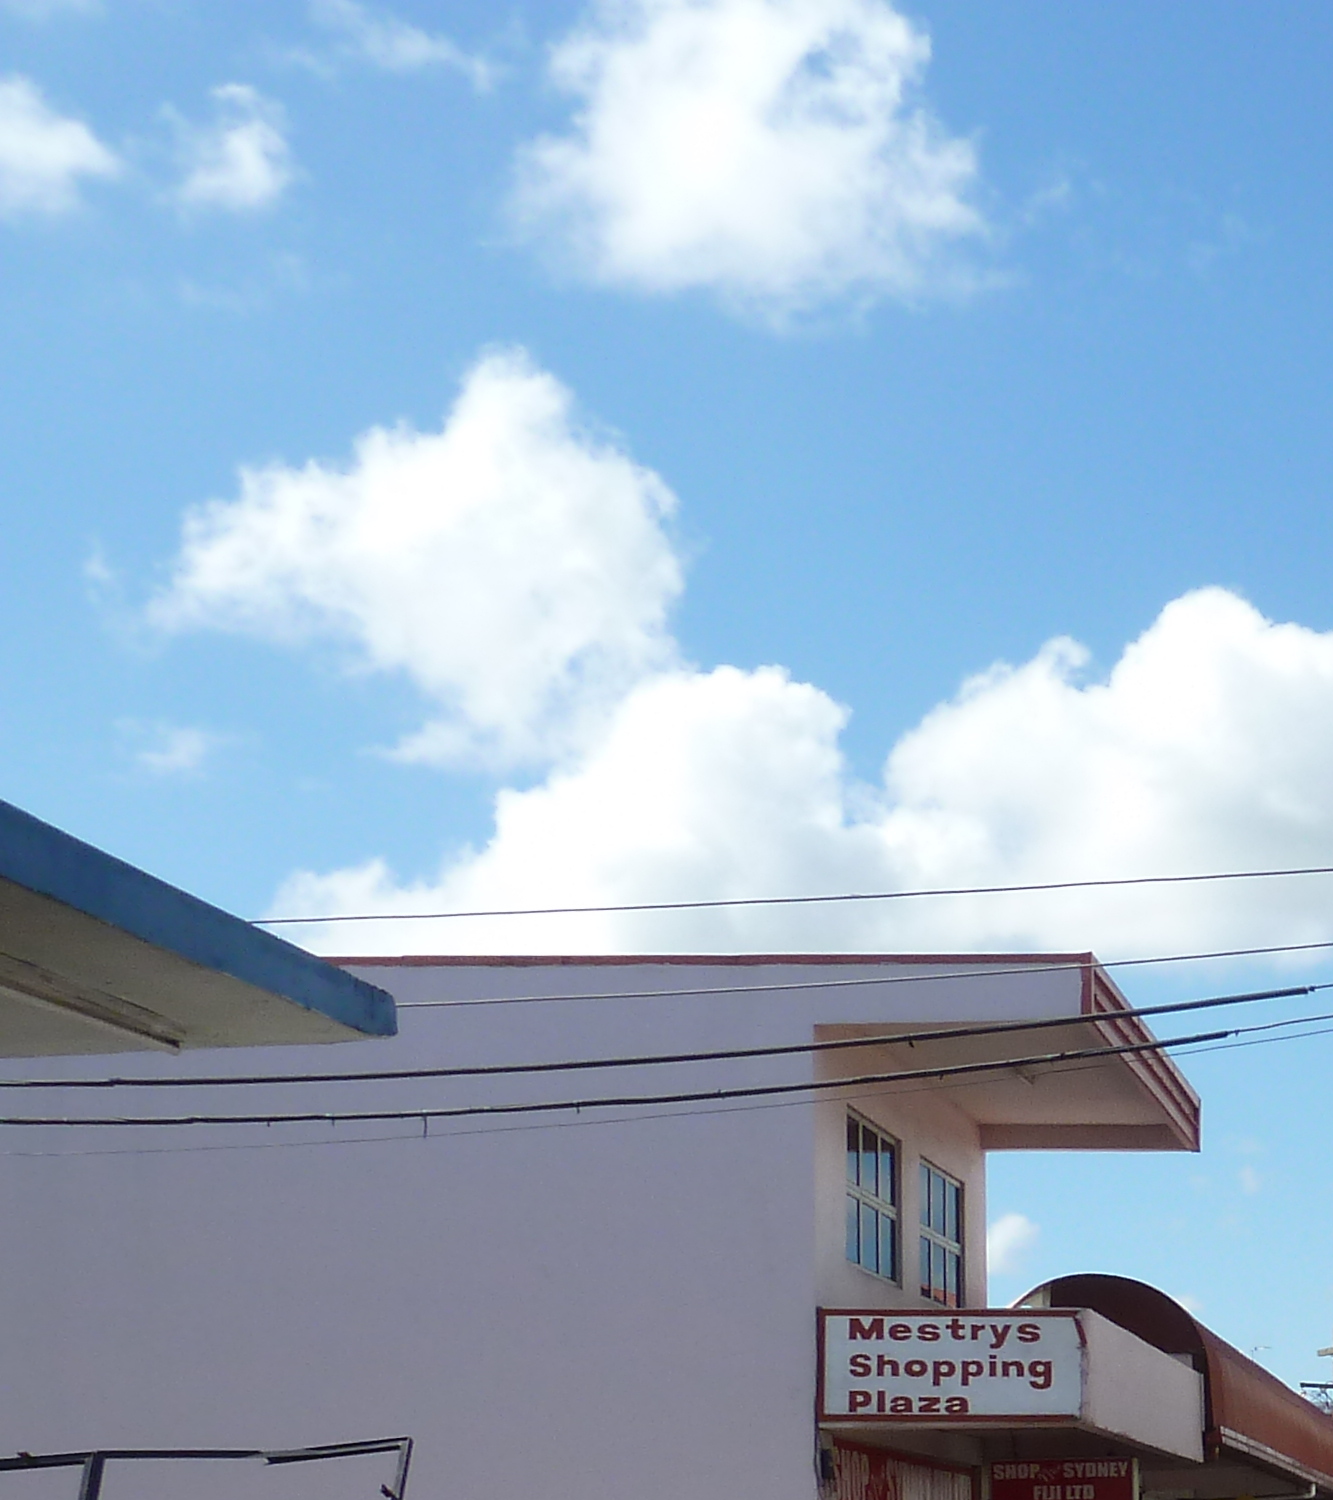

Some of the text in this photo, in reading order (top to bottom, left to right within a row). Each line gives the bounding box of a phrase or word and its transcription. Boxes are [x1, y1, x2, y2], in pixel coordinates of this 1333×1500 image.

[848, 1318, 1041, 1349] Mestrys
[849, 1354, 1052, 1389] Shopping
[848, 1390, 969, 1413] Plaza
[993, 1463, 1041, 1481] SHOP
[1062, 1461, 1129, 1479] SYDNEY
[1065, 1484, 1096, 1500] LTD
